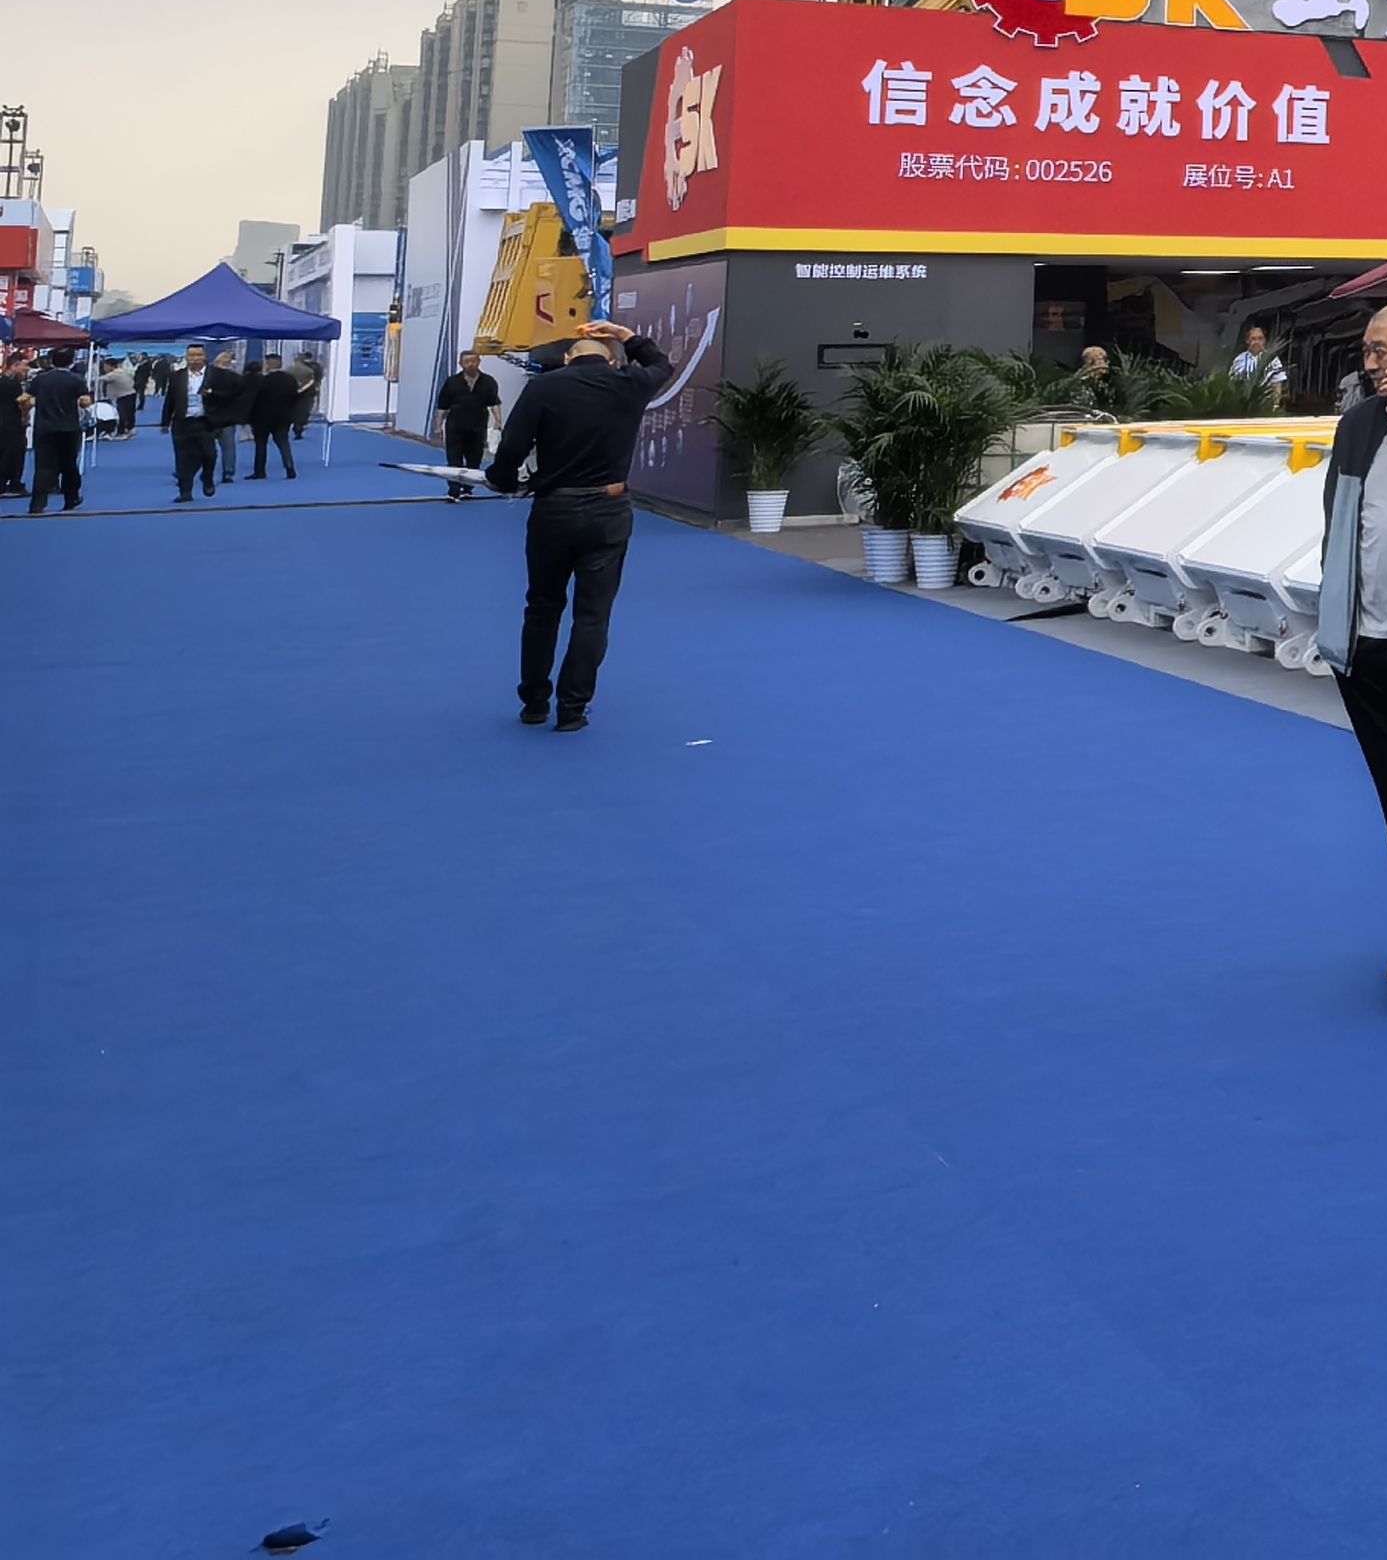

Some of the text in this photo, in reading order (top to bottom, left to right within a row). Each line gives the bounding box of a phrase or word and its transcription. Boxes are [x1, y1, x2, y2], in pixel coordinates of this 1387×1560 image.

[861, 58, 1332, 144] 信念成就价值
